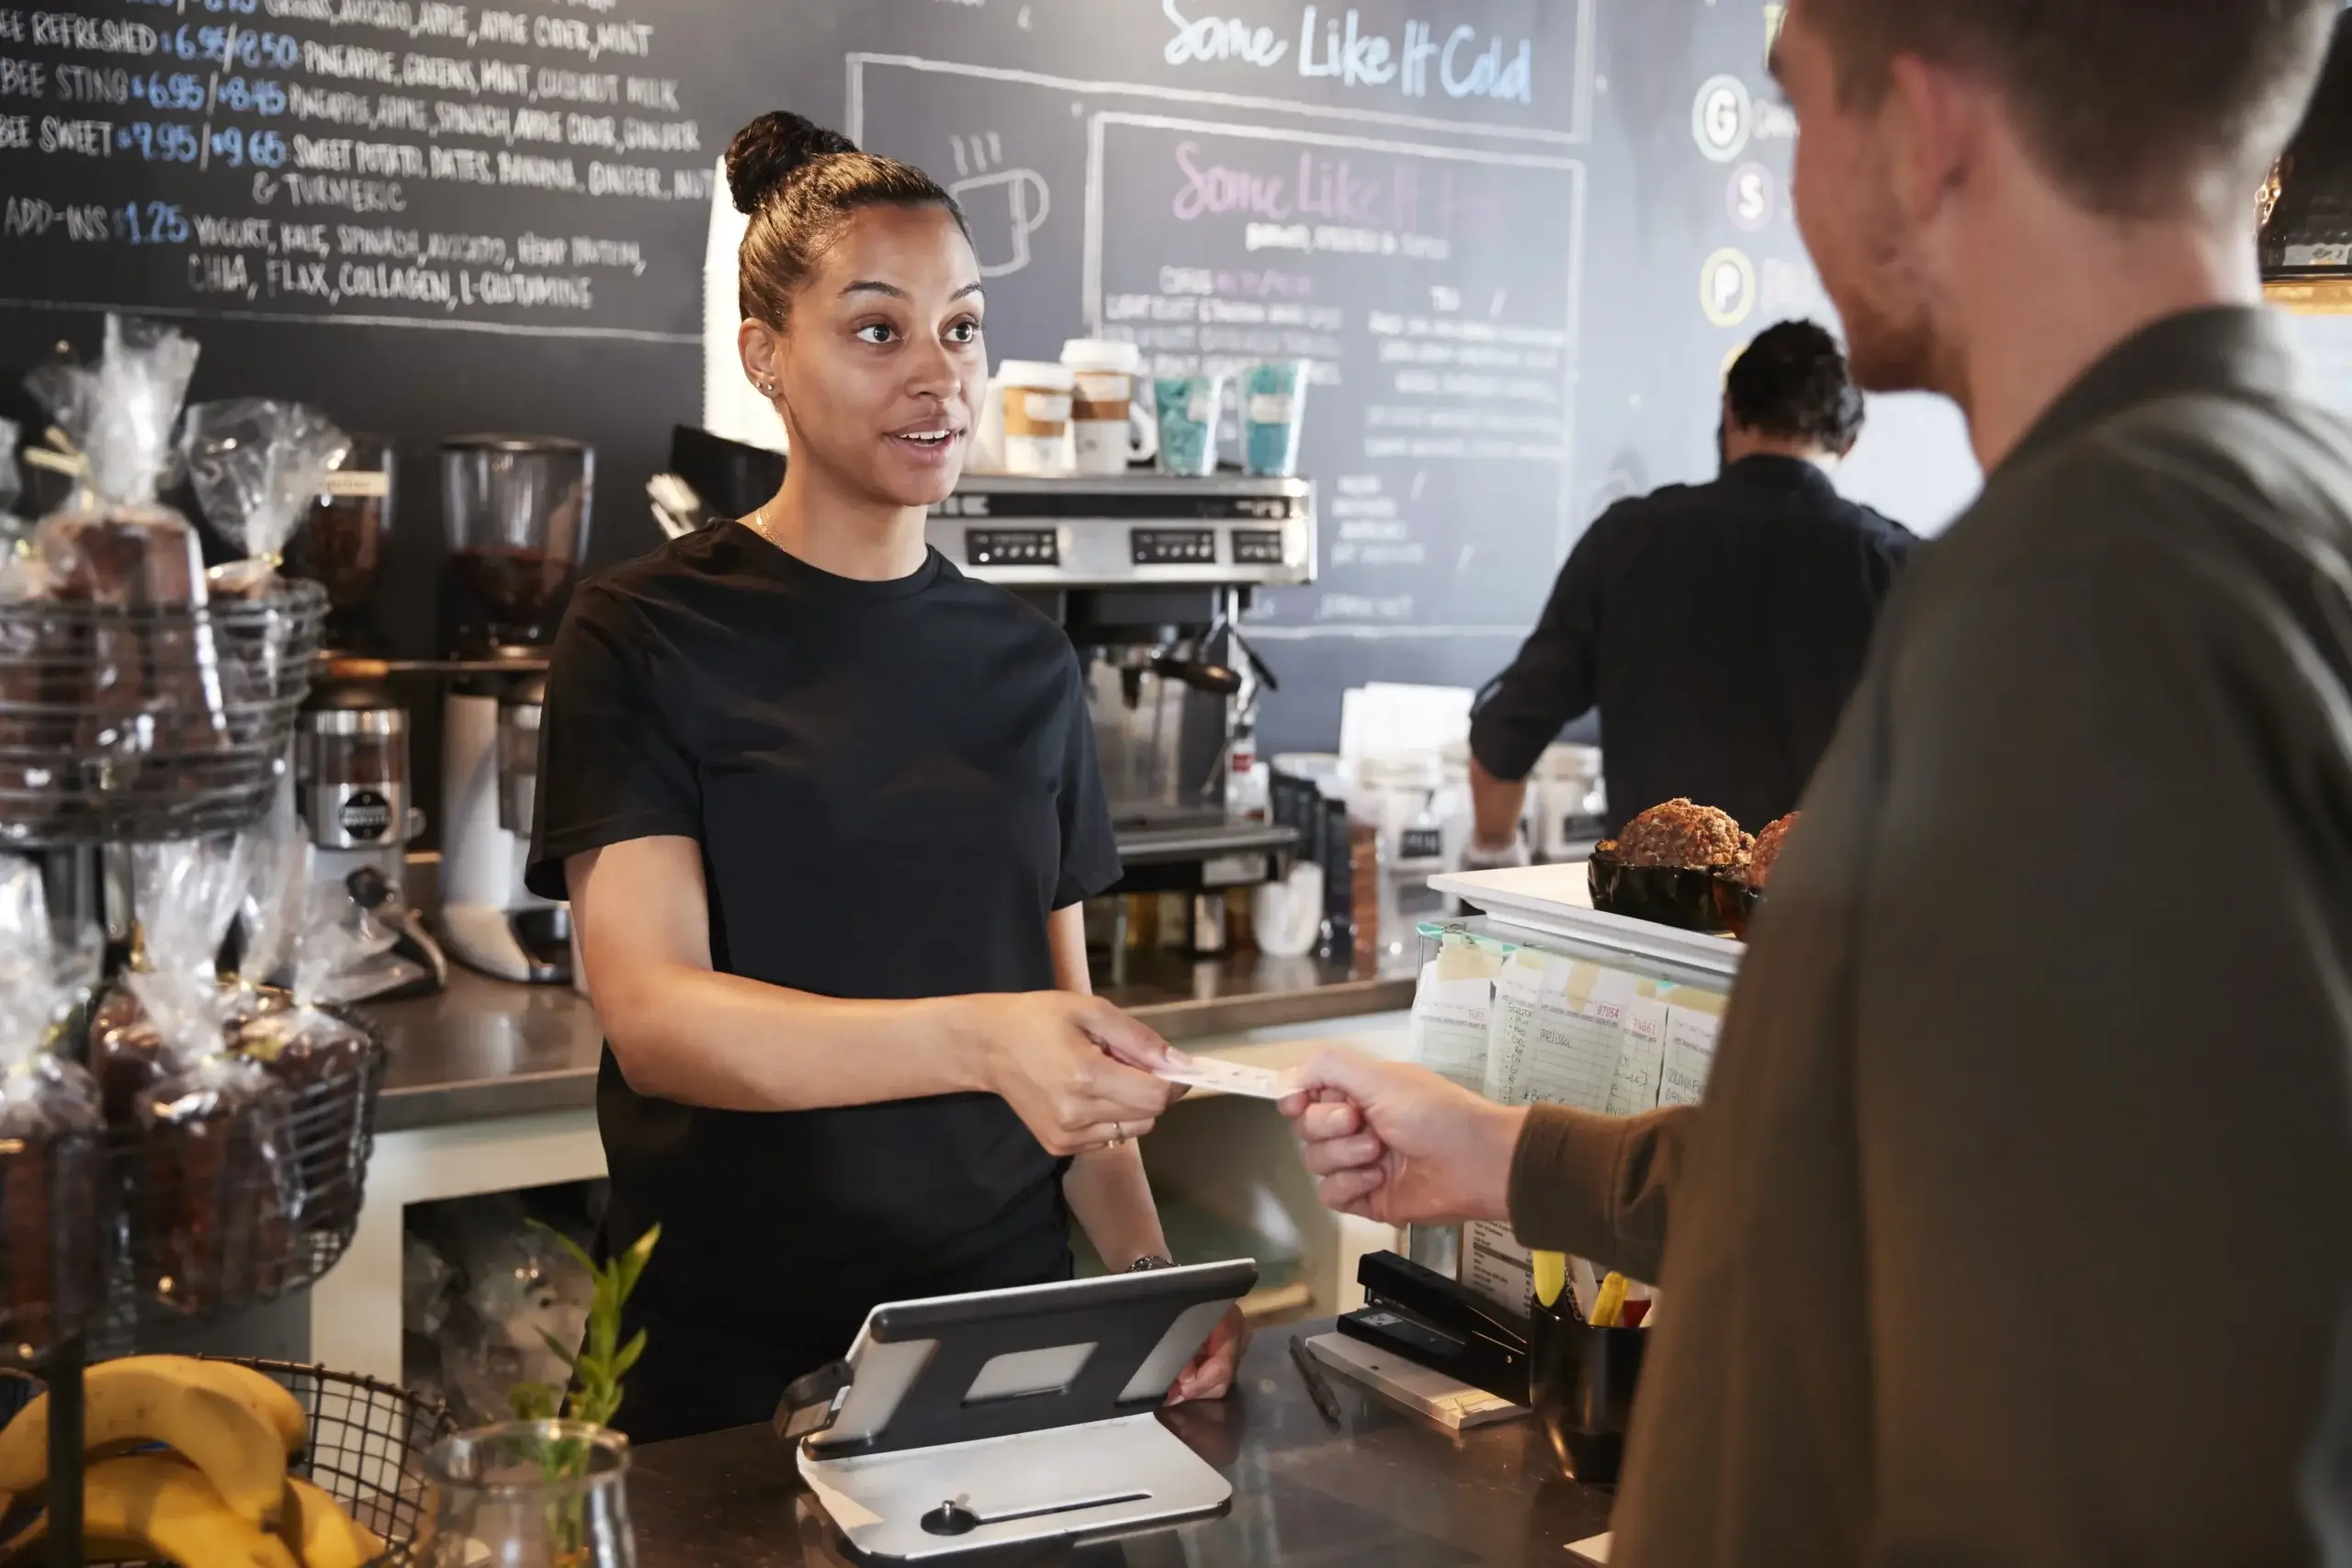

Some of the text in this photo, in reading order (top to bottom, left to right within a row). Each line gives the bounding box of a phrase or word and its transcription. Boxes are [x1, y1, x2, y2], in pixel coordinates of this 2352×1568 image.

[31, 11, 158, 56] REFRESHED
[1162, 0, 1289, 68] Some
[1298, 5, 1397, 86] Like
[1440, 25, 1532, 105] Cold
[39, 115, 114, 158] SWEET
[1172, 141, 1293, 220] Some
[1298, 151, 1390, 224] Like
[1737, 173, 1764, 220] S
[1713, 263, 1740, 313] P
